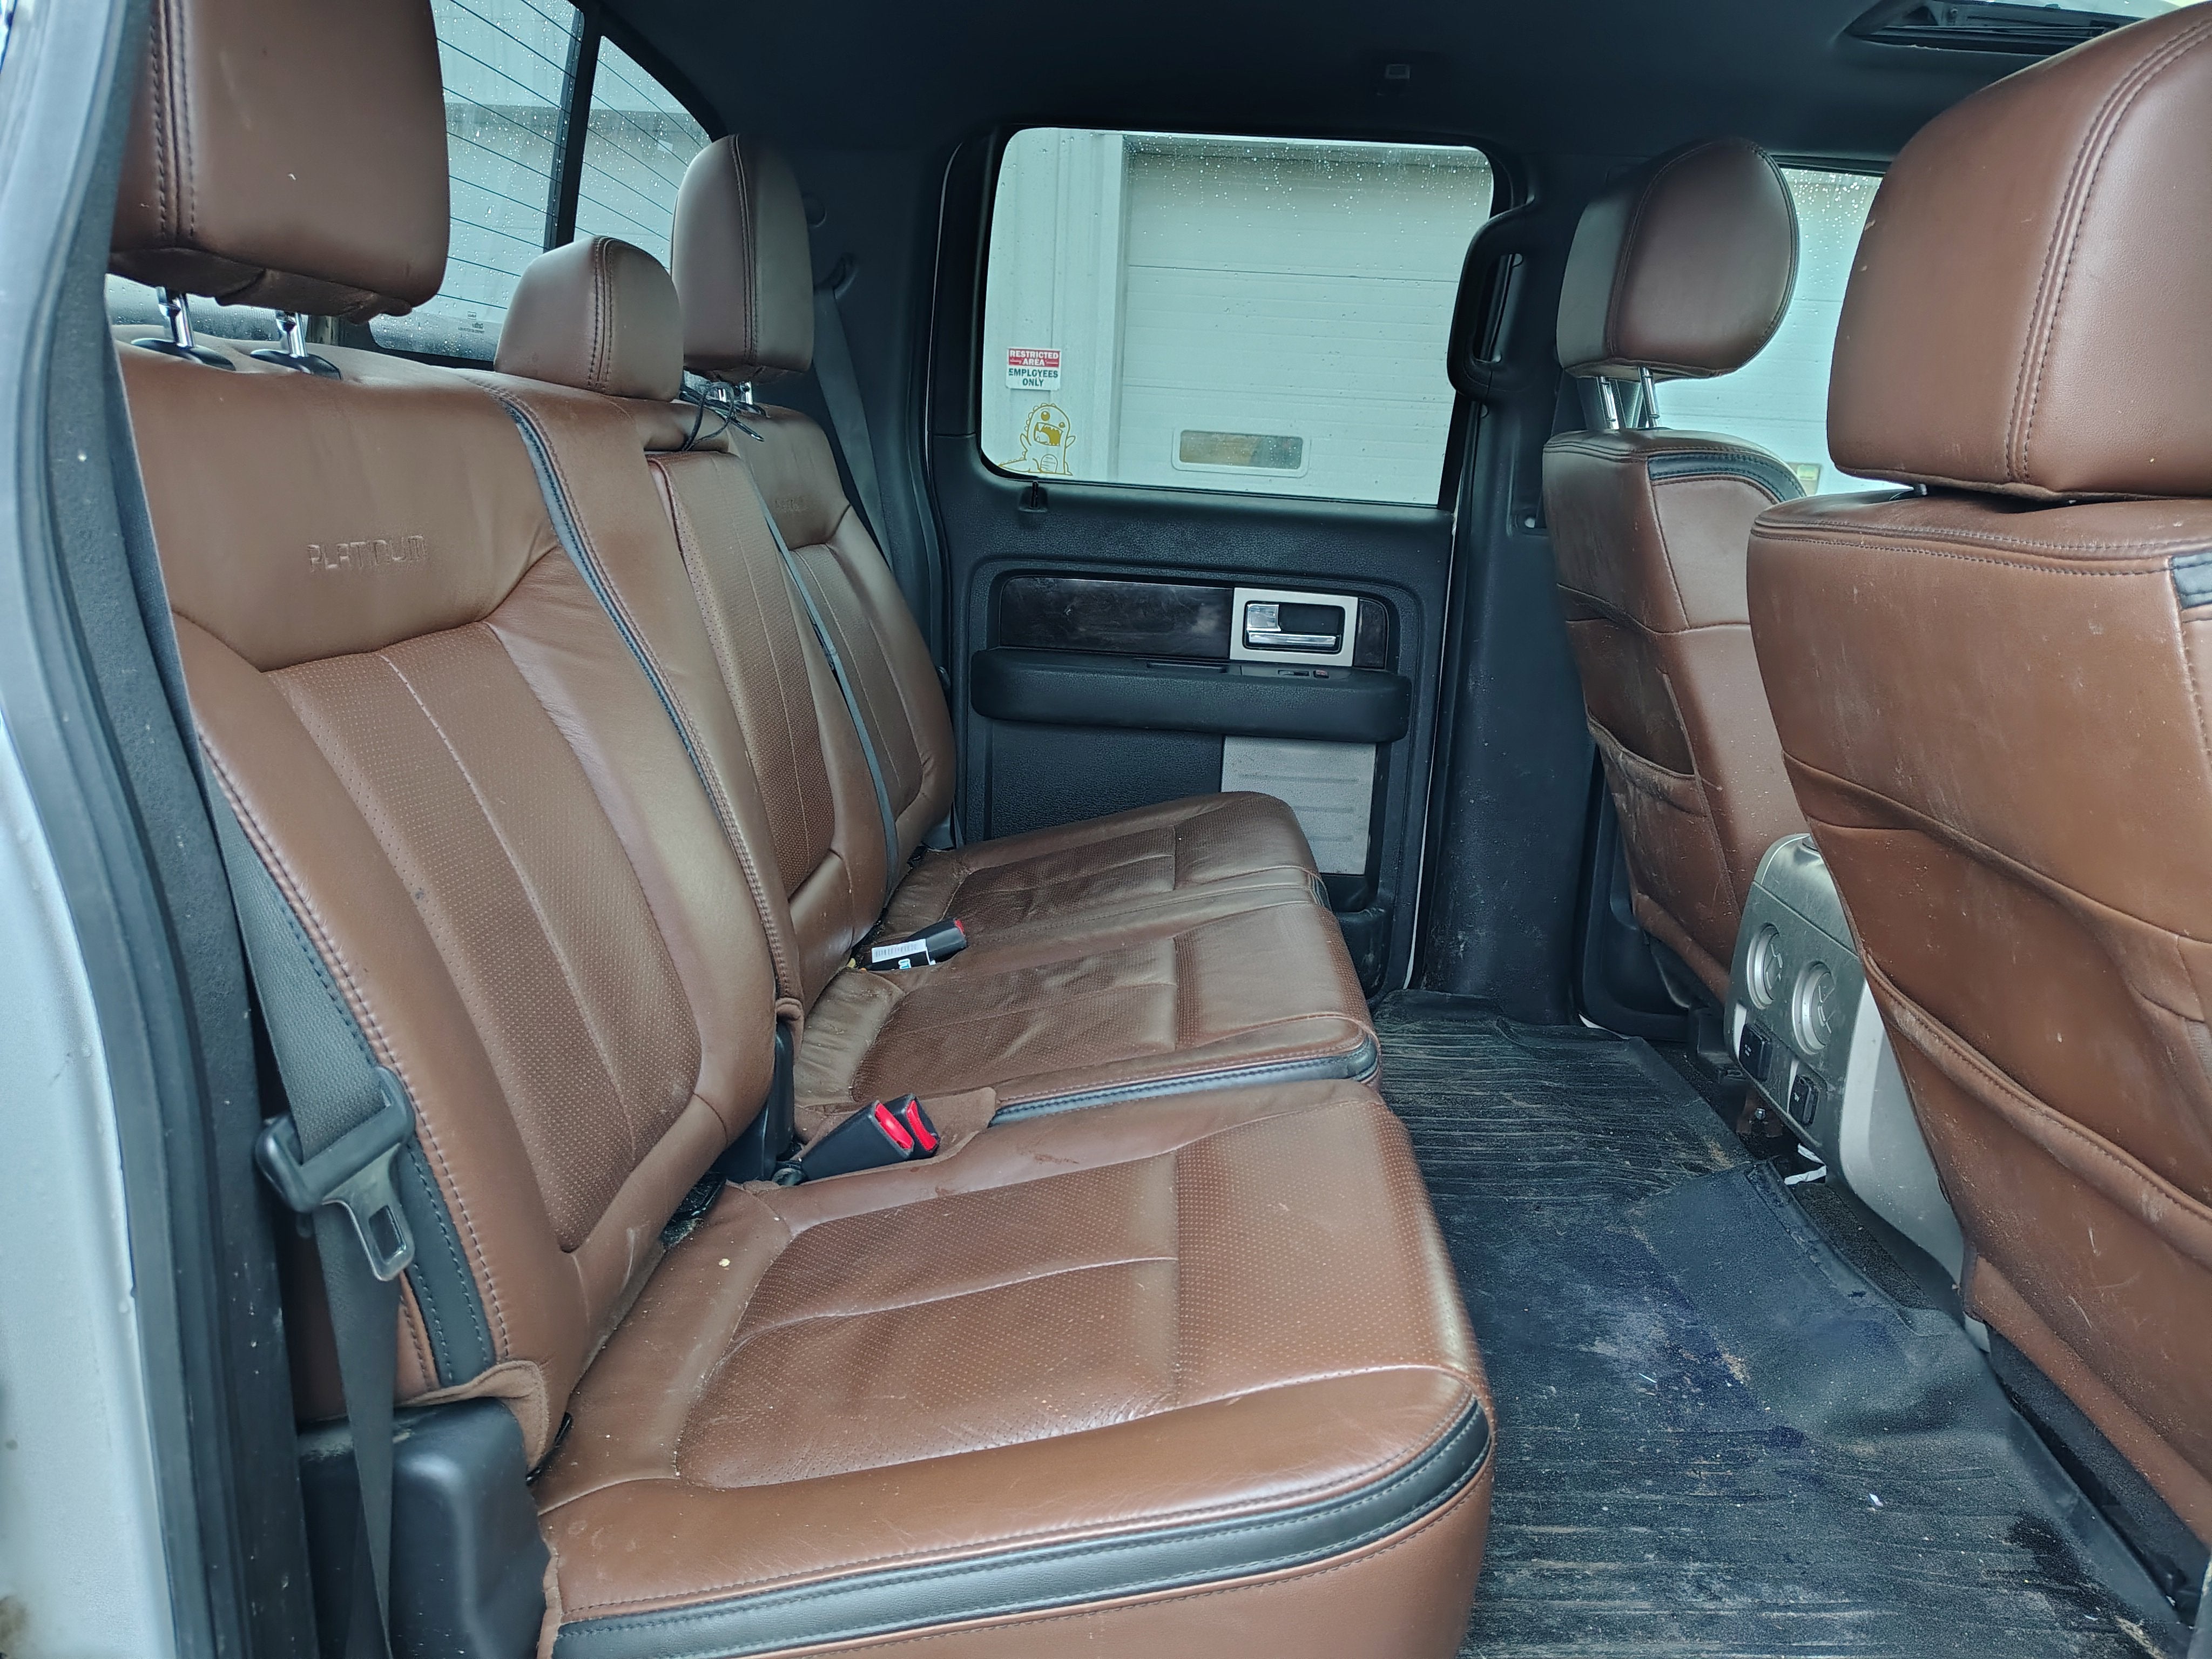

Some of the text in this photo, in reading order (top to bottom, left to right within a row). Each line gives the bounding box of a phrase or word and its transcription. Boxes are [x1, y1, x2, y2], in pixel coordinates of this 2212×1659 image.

[1009, 350, 1059, 359] RESTRICTED
[1022, 358, 1045, 366] AREA
[1008, 368, 1058, 378] EMPLOYEES
[1022, 378, 1044, 387] ONLY
